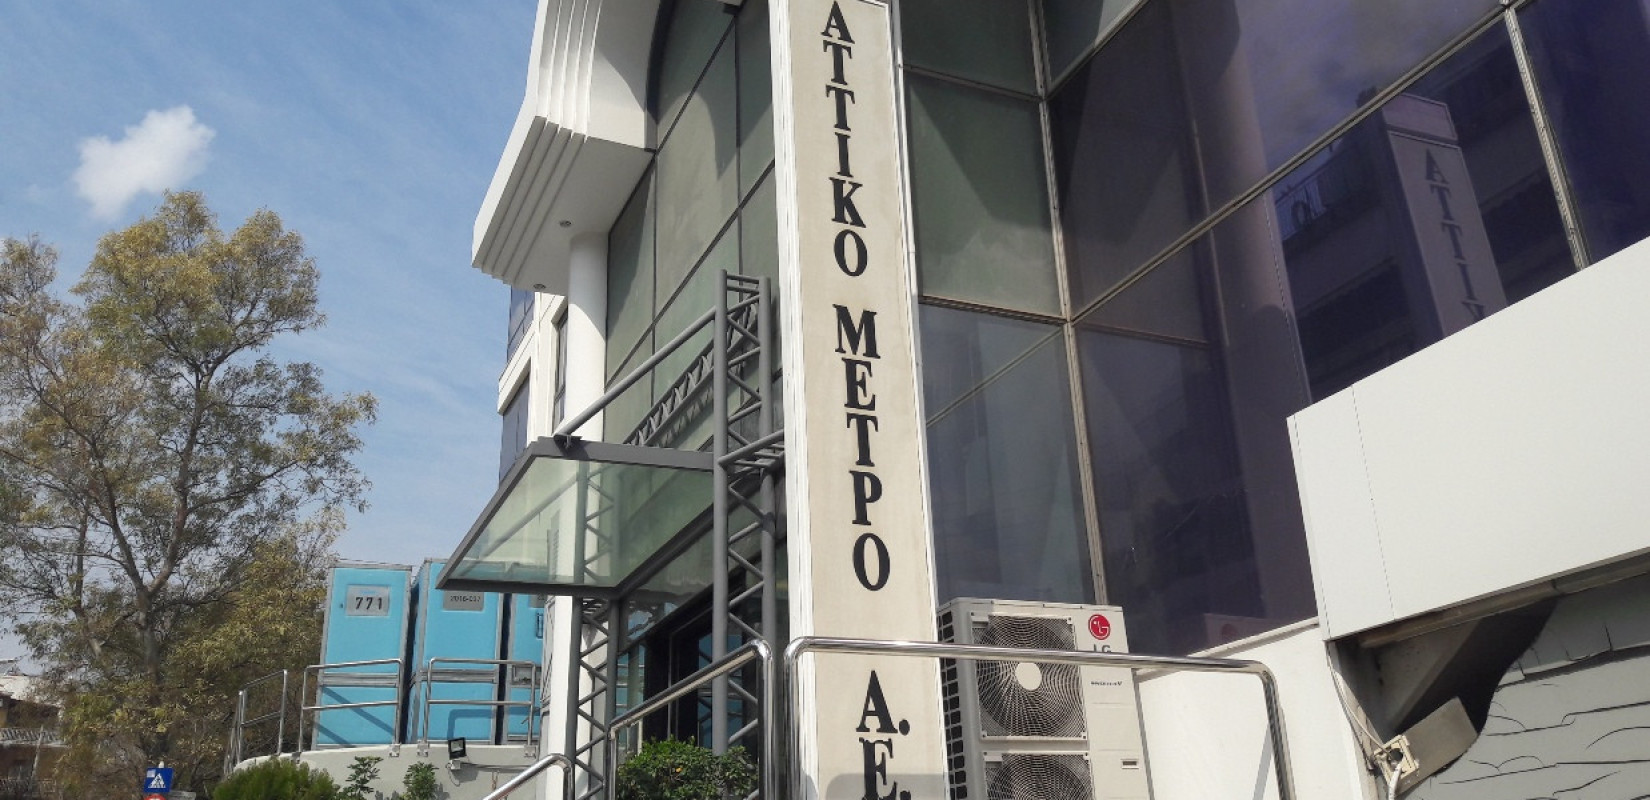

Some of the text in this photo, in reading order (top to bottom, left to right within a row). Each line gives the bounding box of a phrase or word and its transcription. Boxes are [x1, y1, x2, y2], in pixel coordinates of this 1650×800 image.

[821, 0, 868, 277] ΑΤΤΙΚΟ
[832, 303, 891, 591] ΜΕΤΡΟ
[355, 596, 383, 610] 771
